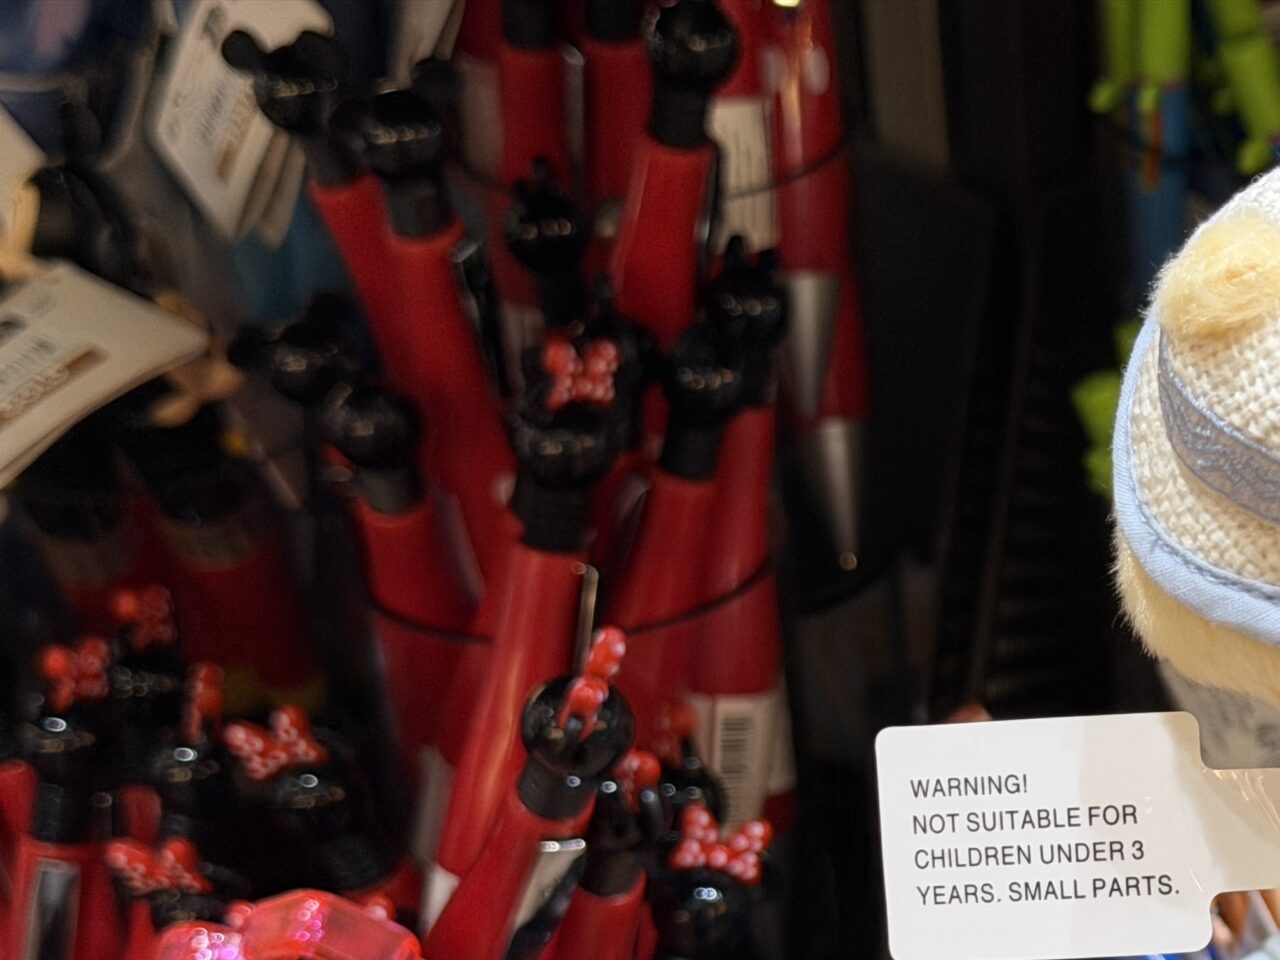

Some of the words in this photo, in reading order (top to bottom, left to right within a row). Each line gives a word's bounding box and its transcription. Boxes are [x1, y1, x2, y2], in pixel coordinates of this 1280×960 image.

[910, 774, 1029, 798] WARNING!
[912, 814, 959, 834] NOT
[966, 807, 1081, 832] SUITABLE
[1088, 804, 1138, 826] FOR
[915, 845, 1031, 869] CHILDREN
[1040, 841, 1125, 864] UNDER
[1132, 840, 1144, 860] 3
[917, 883, 1001, 905] YEARS.
[1008, 880, 1086, 902] SMALL
[1093, 874, 1180, 898] PARTS.
